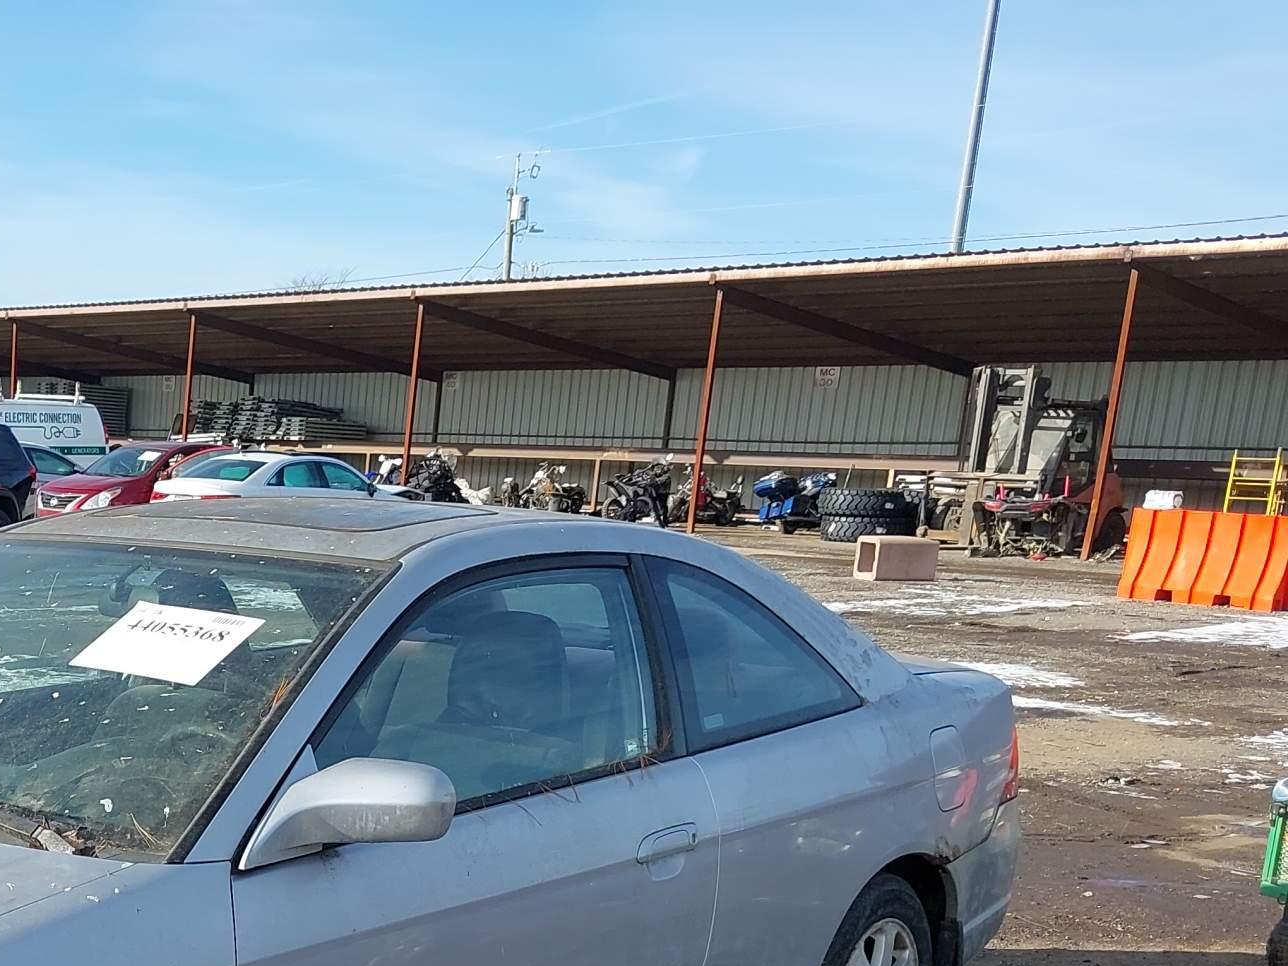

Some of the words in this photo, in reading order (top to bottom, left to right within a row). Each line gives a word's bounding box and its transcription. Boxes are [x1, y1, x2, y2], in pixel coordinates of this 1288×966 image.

[819, 368, 836, 376] MC
[4, 411, 37, 423] ELECTRIC
[39, 412, 82, 424] CONNECTION
[127, 618, 231, 643] 44055368
